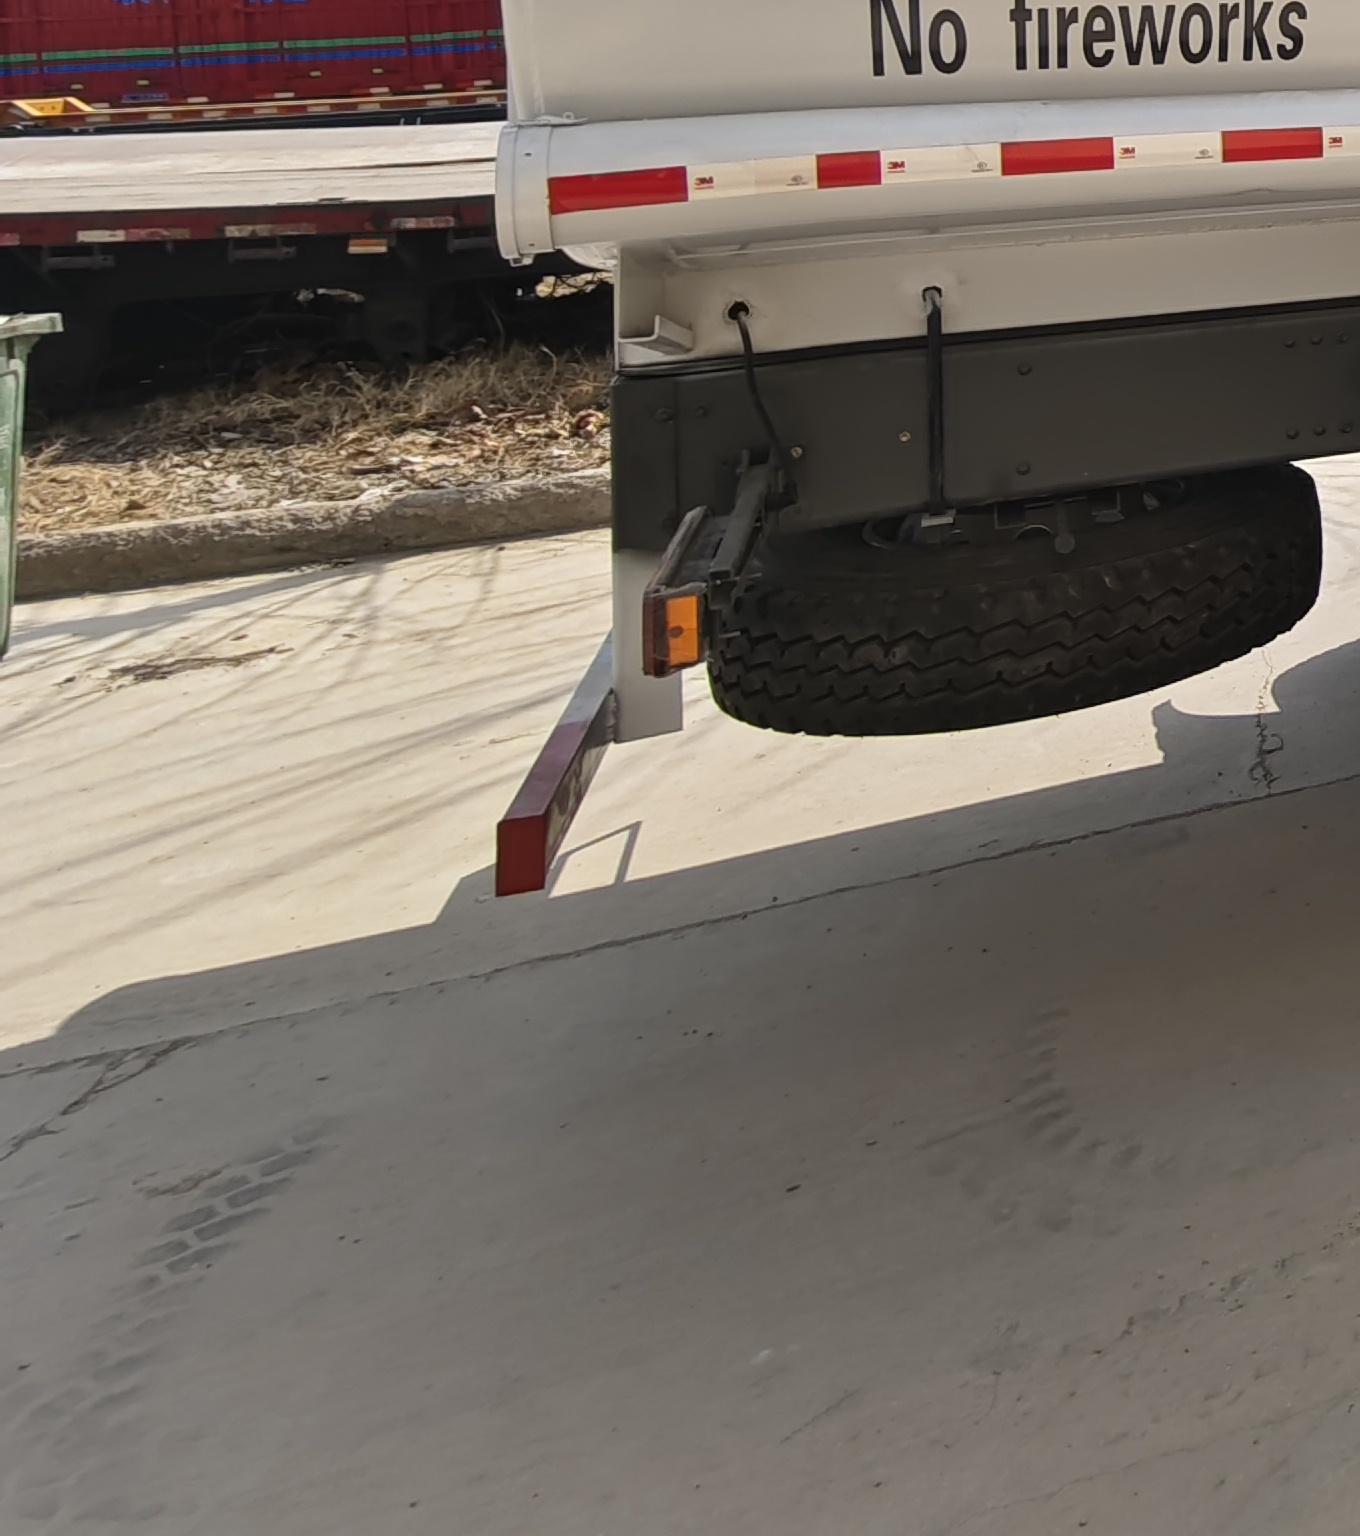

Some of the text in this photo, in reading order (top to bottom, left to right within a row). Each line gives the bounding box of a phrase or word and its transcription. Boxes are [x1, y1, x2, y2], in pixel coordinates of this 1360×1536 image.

[1328, 137, 1343, 145] 3M
[1118, 147, 1136, 155] 3M
[886, 161, 906, 170] 3M
[694, 176, 715, 186] 3M
